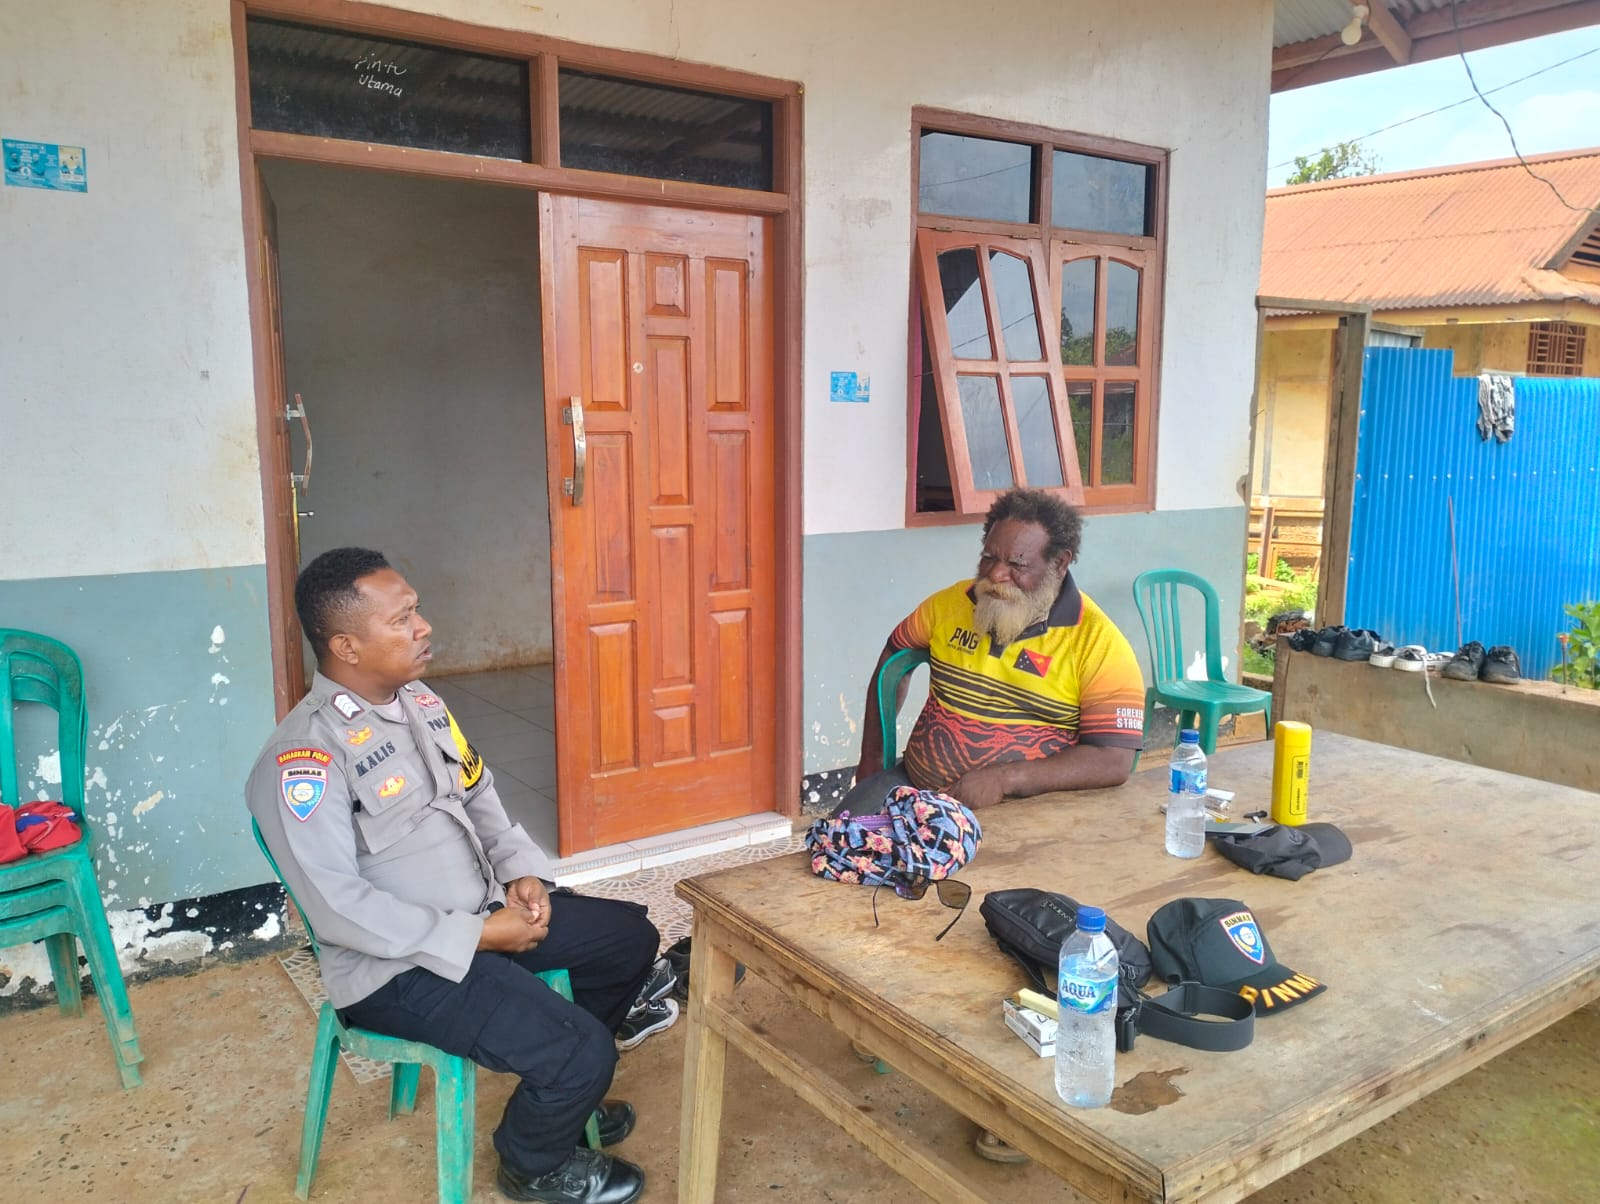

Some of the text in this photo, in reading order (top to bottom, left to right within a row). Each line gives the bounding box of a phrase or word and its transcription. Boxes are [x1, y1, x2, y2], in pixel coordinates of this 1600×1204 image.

[949, 627, 979, 650] PNG
[355, 740, 396, 777] KALIS
[288, 769, 322, 777] BINMAS
[1062, 979, 1097, 1000] AQUA
